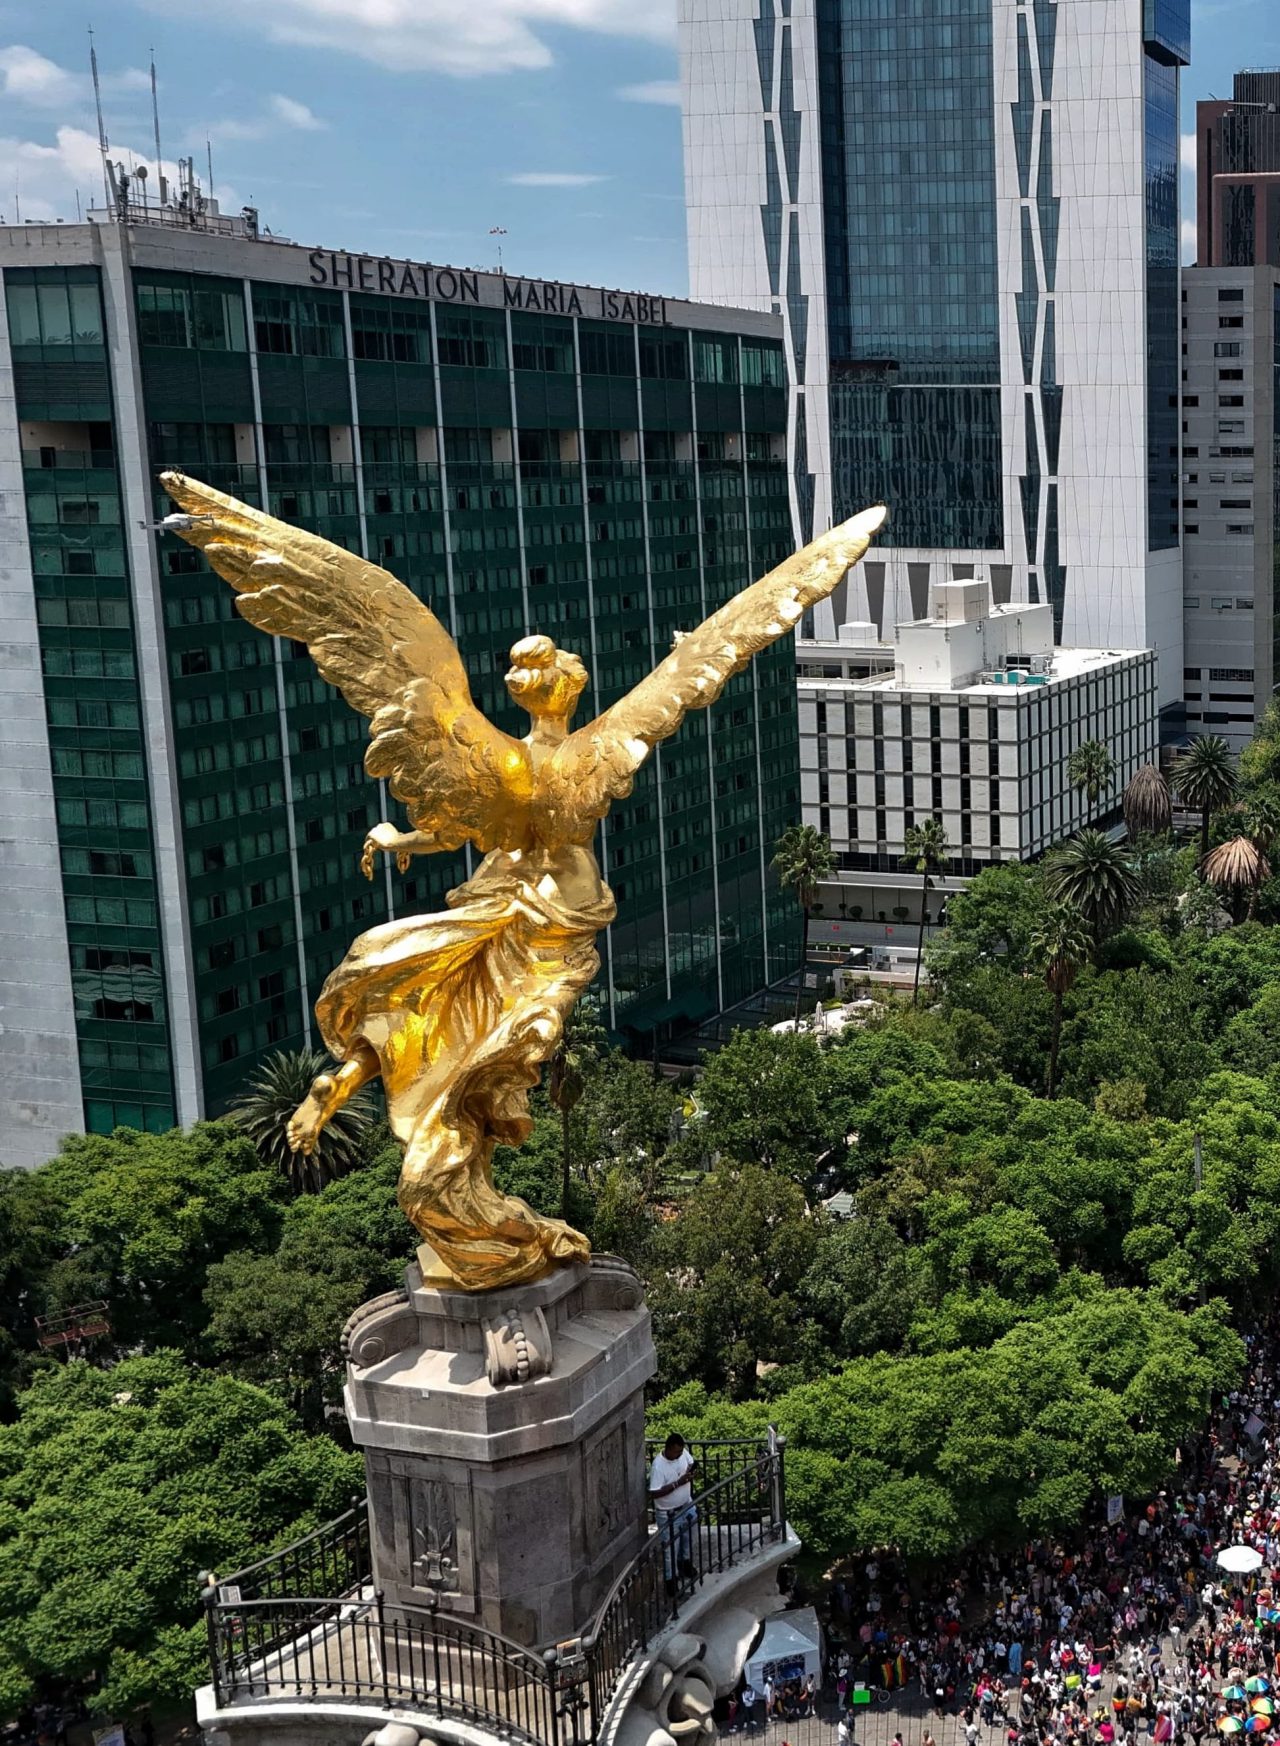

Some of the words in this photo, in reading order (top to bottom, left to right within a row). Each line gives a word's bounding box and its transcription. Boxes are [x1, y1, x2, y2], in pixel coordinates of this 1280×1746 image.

[309, 251, 479, 303] SHERATON
[503, 278, 583, 315] MARIA
[601, 290, 673, 325] ISABEL
